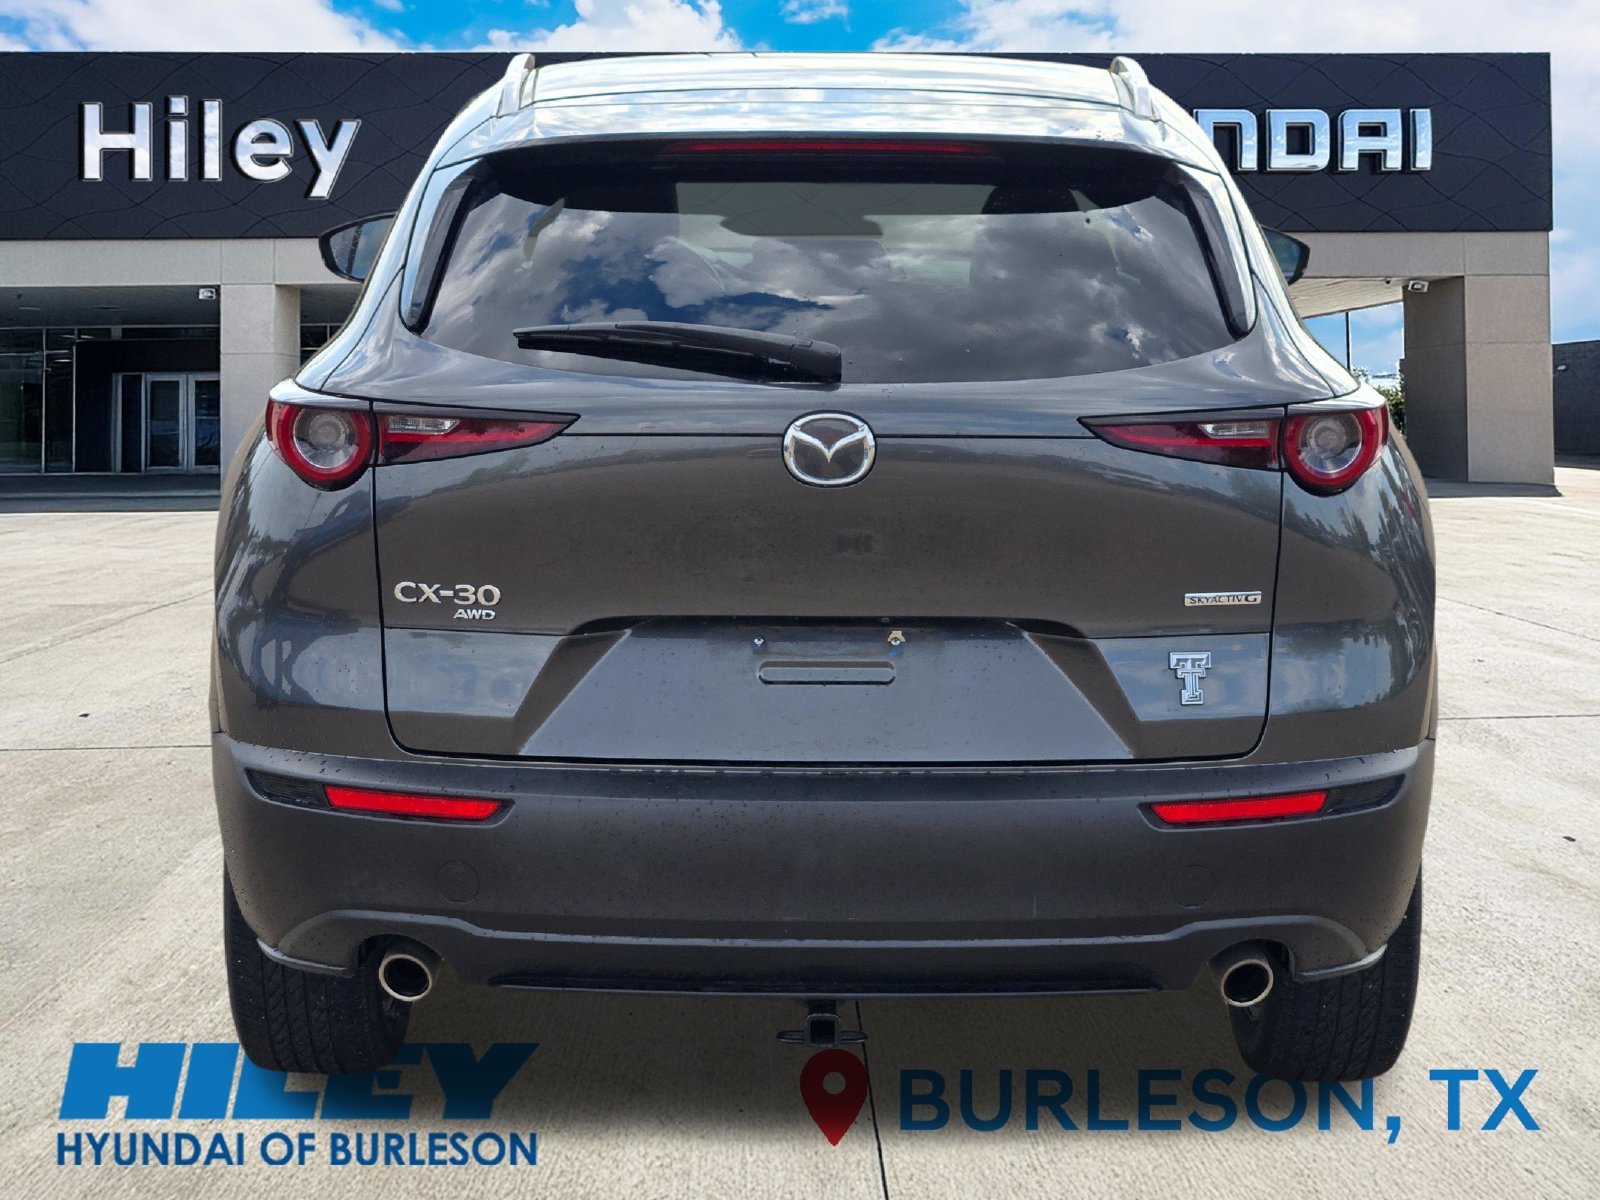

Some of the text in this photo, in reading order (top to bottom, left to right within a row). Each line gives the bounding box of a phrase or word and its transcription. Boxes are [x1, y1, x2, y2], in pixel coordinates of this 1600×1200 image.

[80, 95, 362, 199] Hiley
[394, 581, 501, 606] CX-30
[453, 608, 496, 620] AWD
